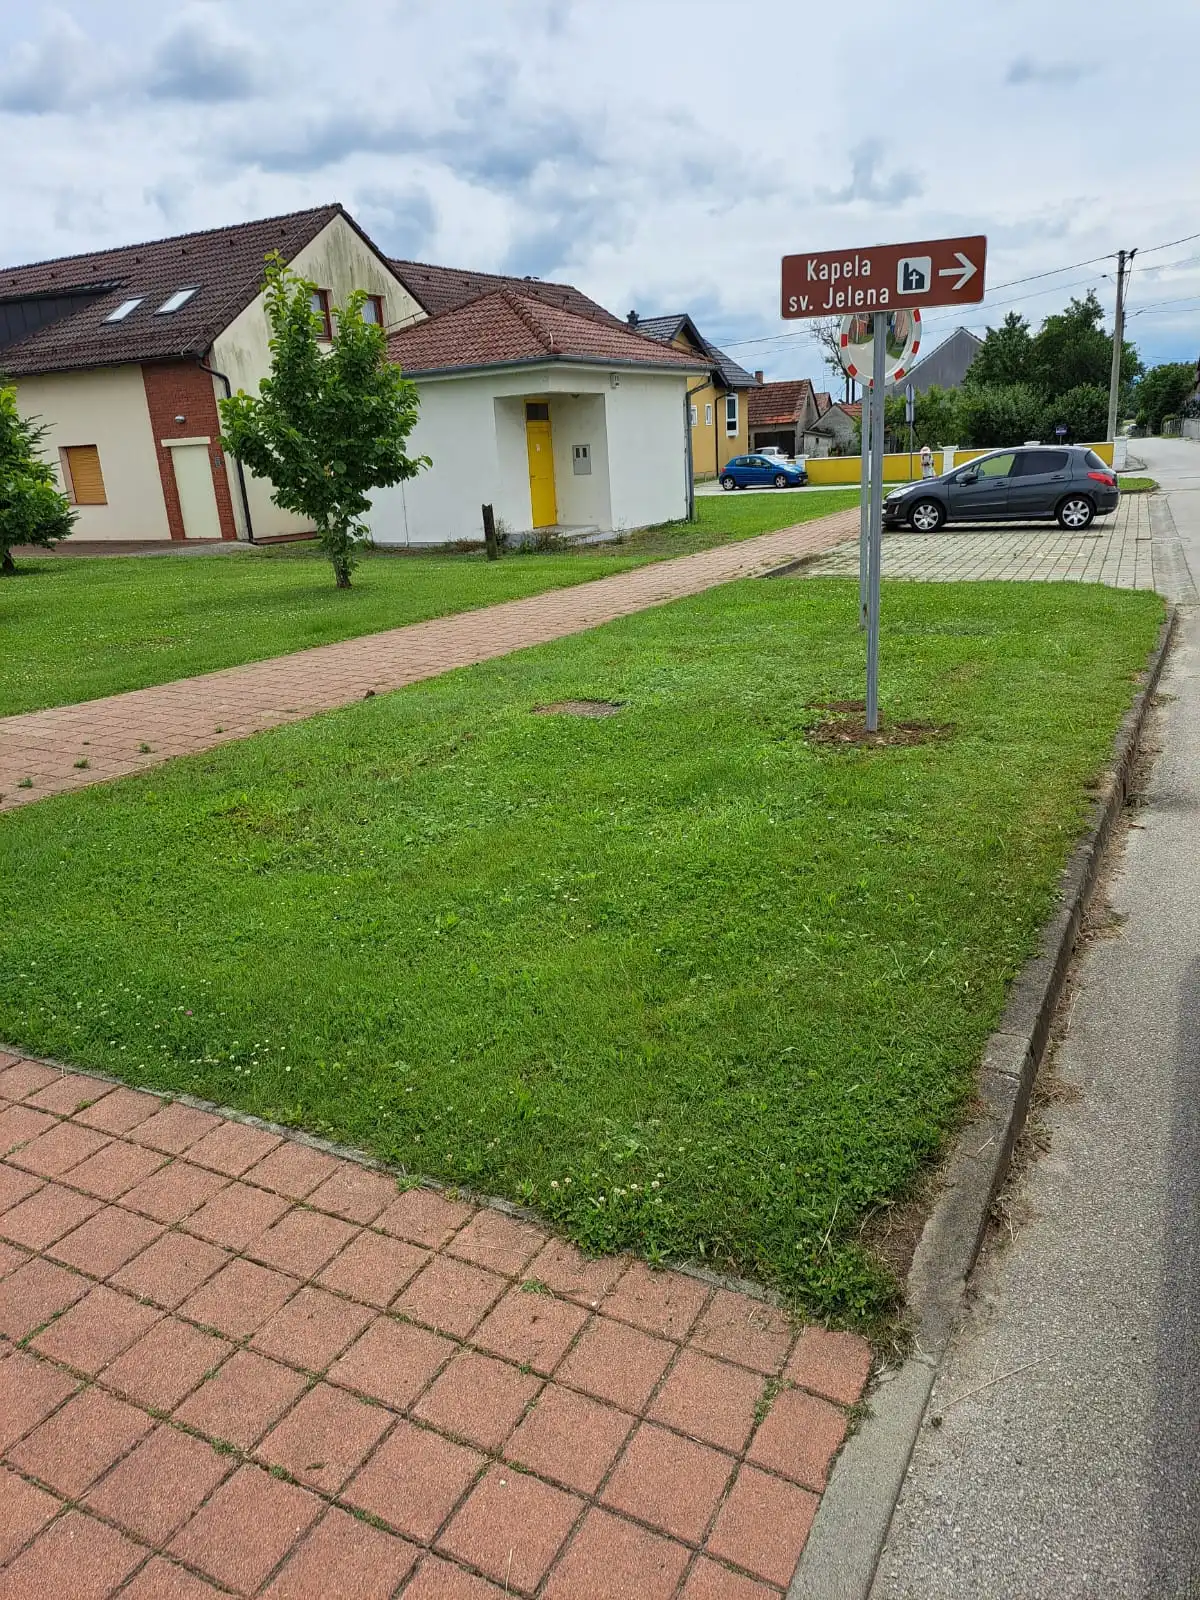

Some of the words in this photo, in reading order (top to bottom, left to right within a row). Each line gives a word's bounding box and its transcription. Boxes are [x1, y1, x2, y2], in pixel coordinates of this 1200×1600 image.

[807, 255, 871, 284] Kapela
[788, 294, 814, 312] sv.
[822, 286, 889, 309] Jelena
